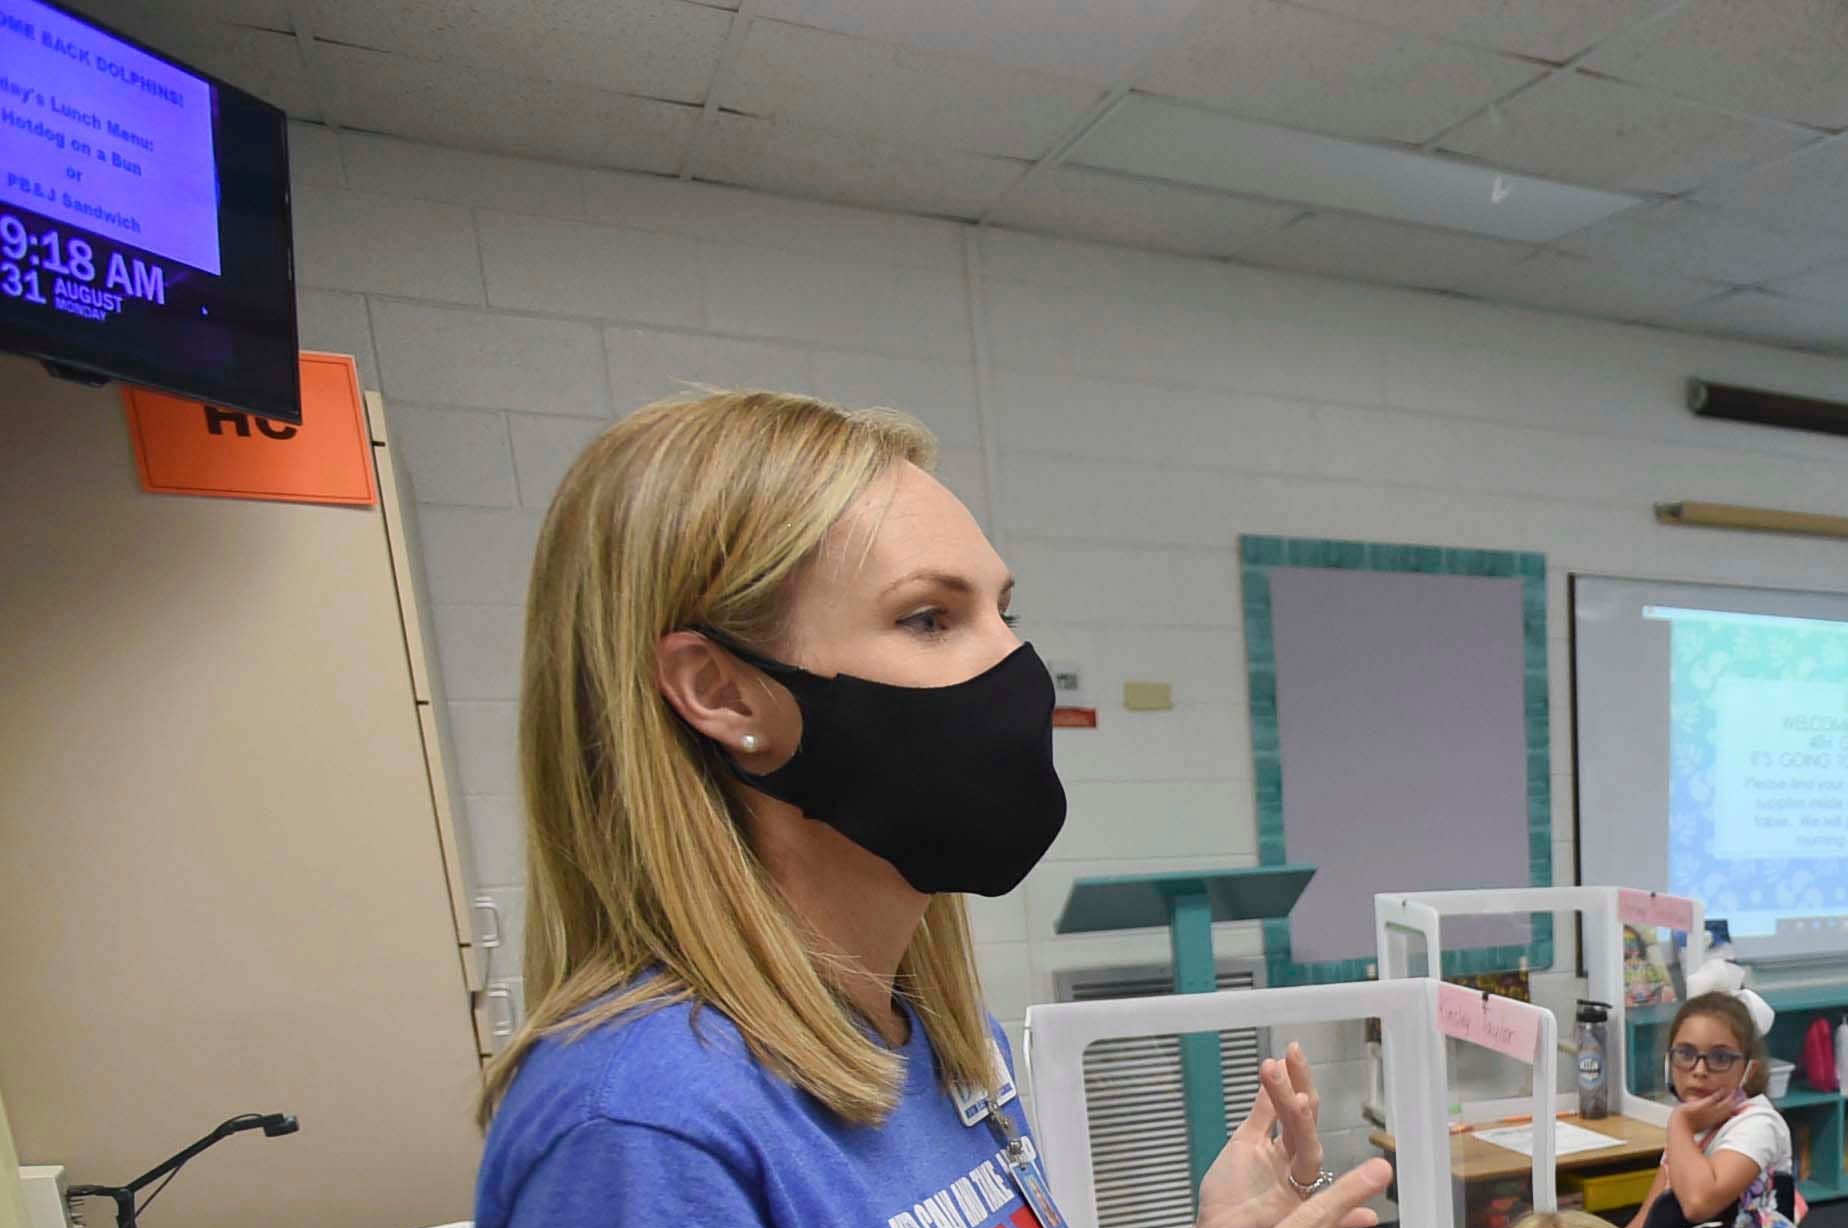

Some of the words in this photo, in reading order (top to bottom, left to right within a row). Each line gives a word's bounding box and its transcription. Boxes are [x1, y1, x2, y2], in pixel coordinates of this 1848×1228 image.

[41, 31, 90, 66] BACK
[96, 56, 184, 108] DOLPHINS!
[2, 109, 65, 149] Hotdog
[71, 138, 91, 157] on
[96, 149, 107, 163] a
[112, 152, 142, 177] Bun
[51, 96, 102, 131] Lunch
[107, 119, 154, 152] Menu:
[66, 165, 83, 183] or
[7, 172, 56, 203] PB&J
[62, 193, 141, 233] Sandwich
[0, 214, 96, 282] 9:18
[106, 252, 165, 305] AM
[0, 262, 47, 305] 31
[54, 277, 123, 314] AUGUST
[54, 297, 107, 321] MONDAY
